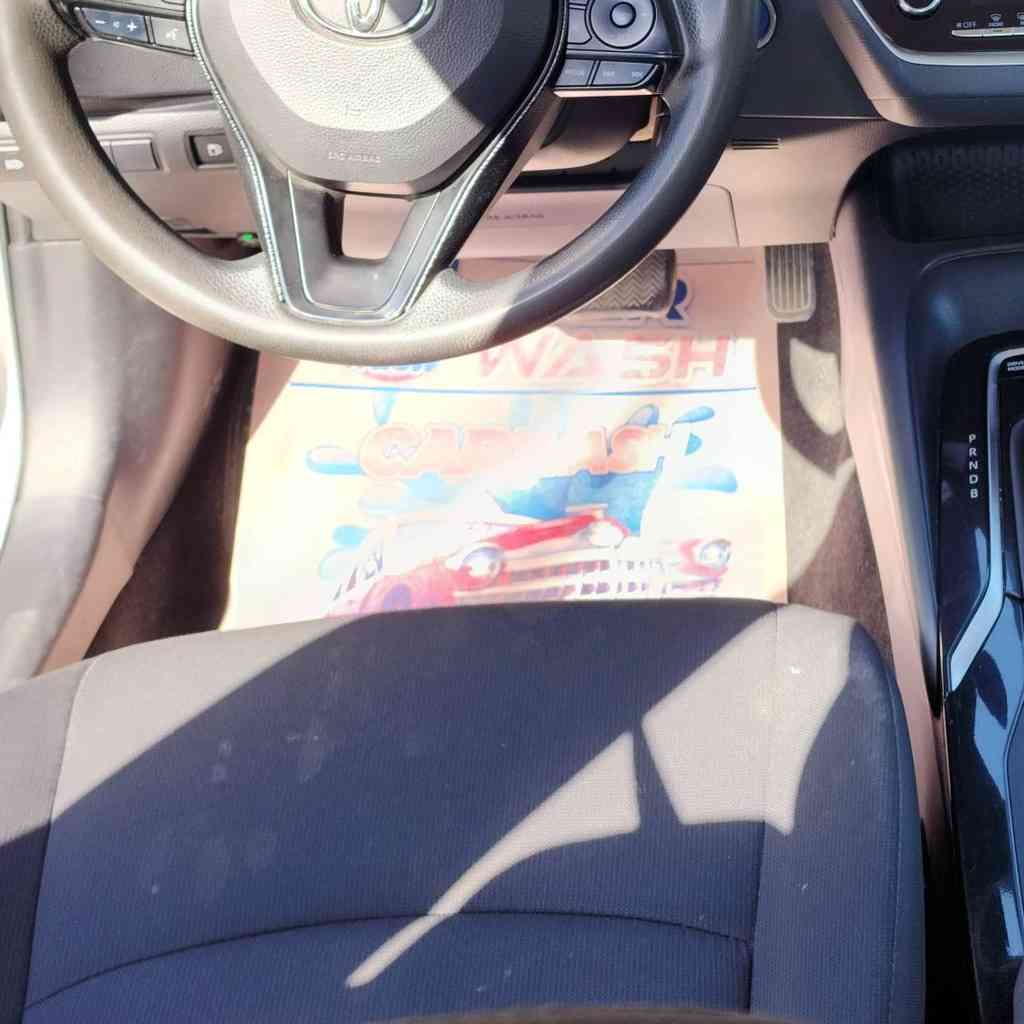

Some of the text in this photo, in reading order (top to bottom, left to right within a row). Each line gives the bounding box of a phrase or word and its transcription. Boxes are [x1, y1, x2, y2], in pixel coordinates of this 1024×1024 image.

[969, 434, 976, 443] P
[969, 448, 977, 456] R
[969, 461, 978, 470] N
[970, 475, 978, 484] D
